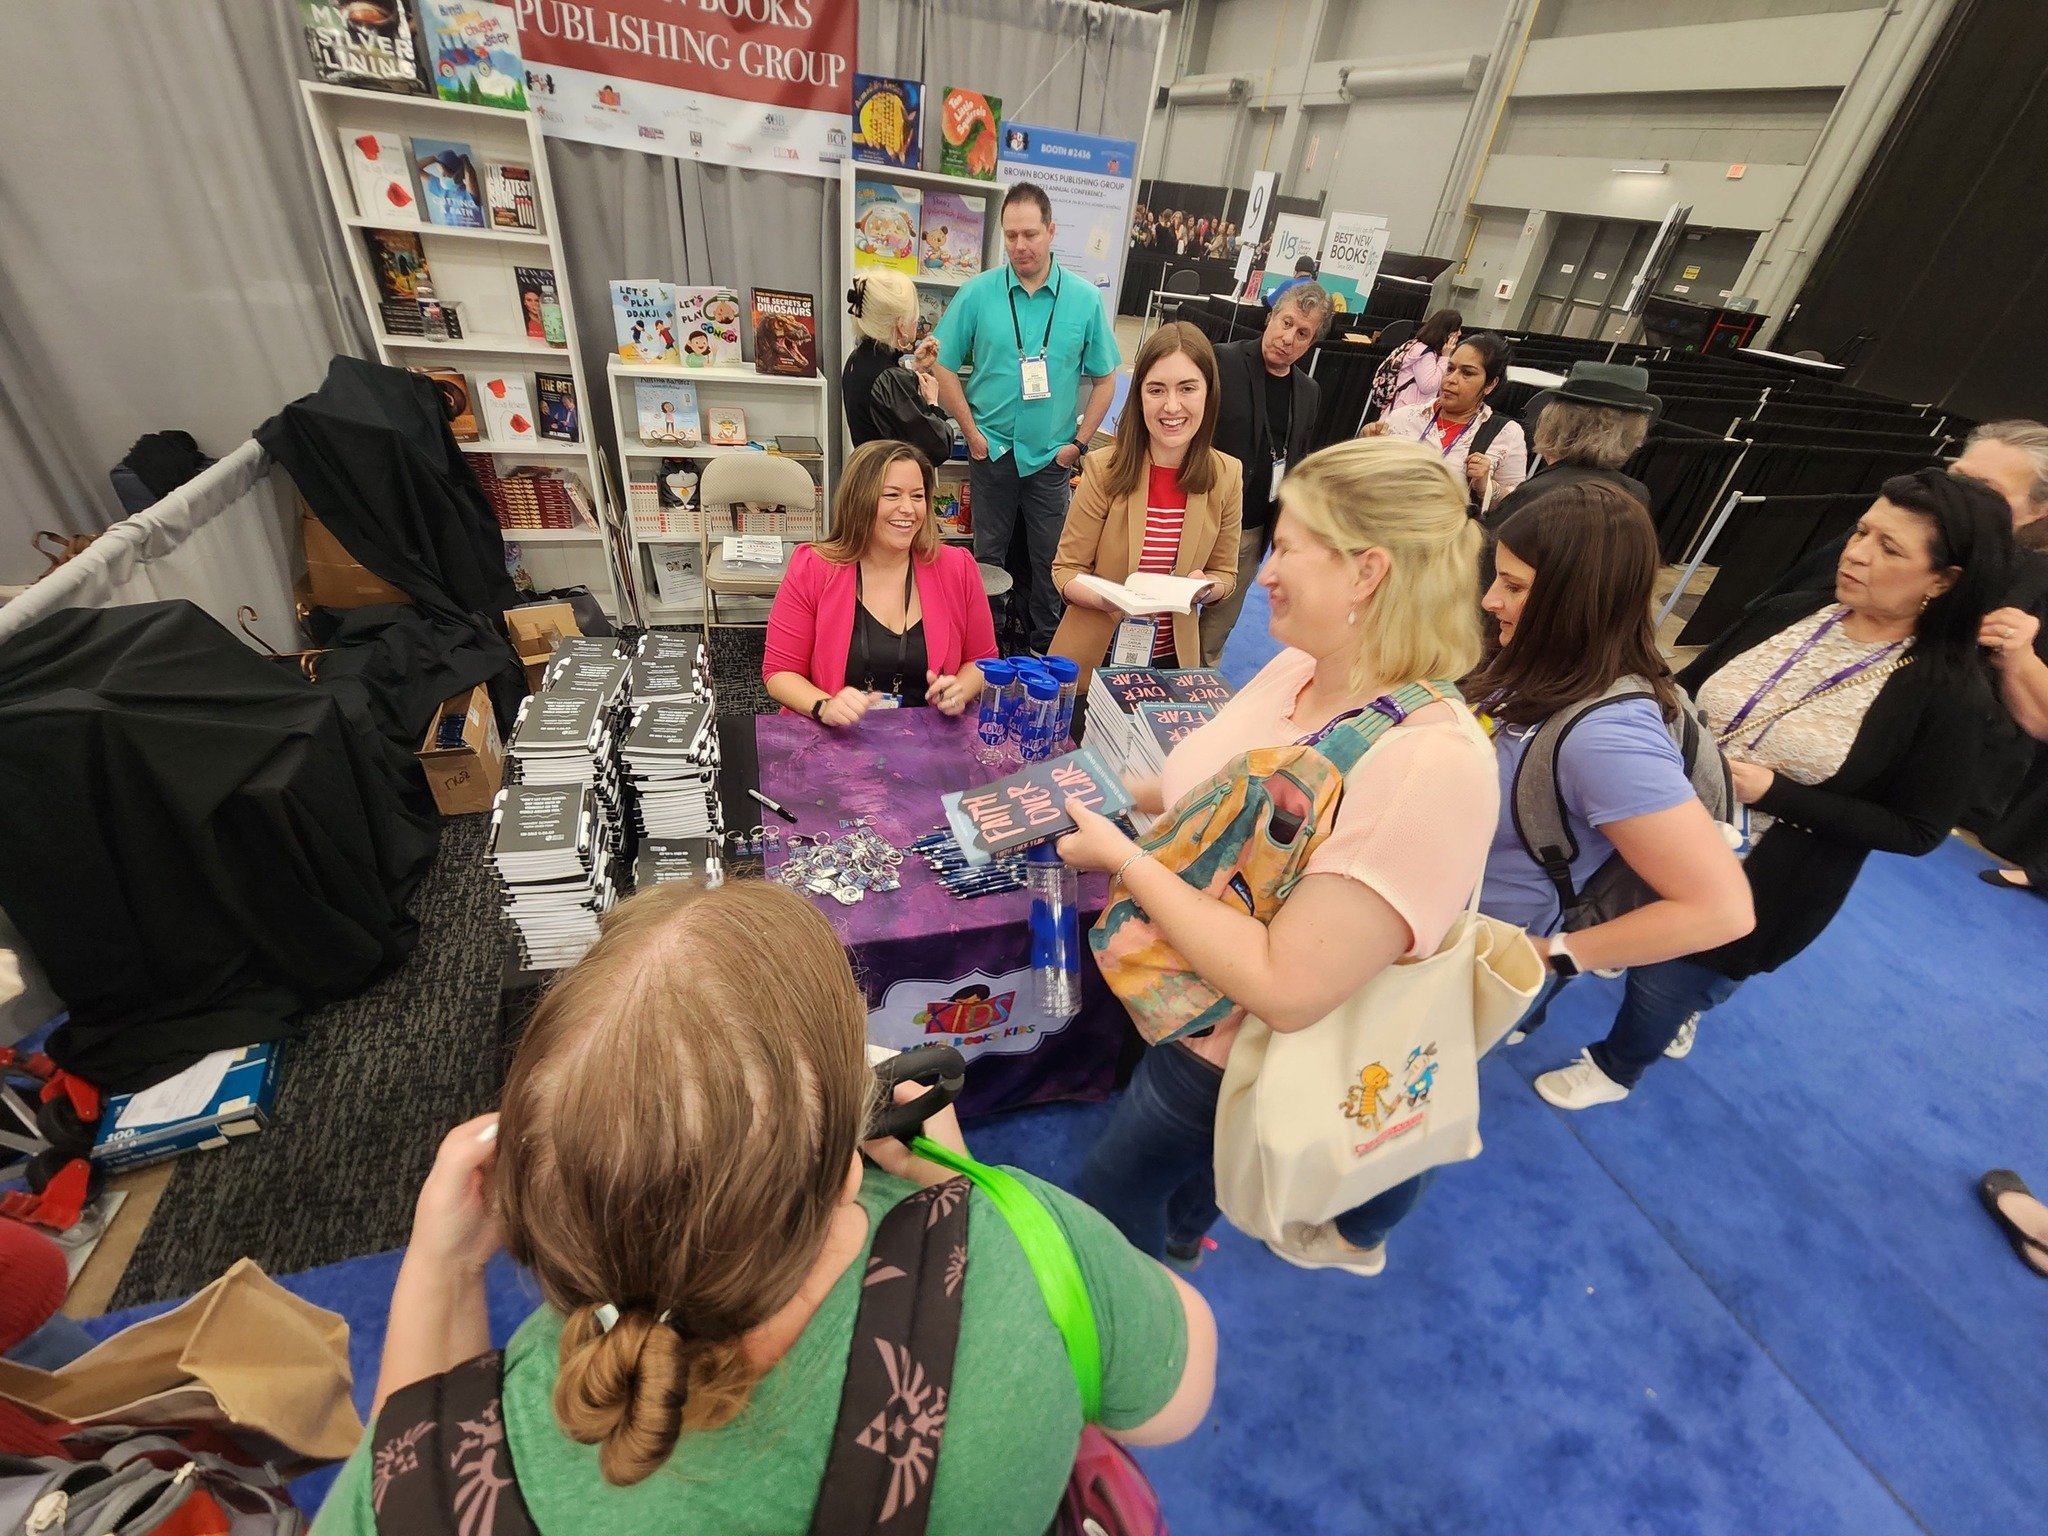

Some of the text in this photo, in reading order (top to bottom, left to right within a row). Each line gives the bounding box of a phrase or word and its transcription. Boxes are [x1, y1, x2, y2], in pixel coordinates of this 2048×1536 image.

[311, 3, 348, 27] MY
[317, 26, 415, 60] SILVER
[514, 0, 847, 88] PUBLISHING GROUP
[323, 48, 417, 80] LINING
[1041, 143, 1067, 156] BOOTH
[1004, 167, 1125, 190] BROWN BOOKS PUBLISHING GROUP
[433, 197, 476, 207] CUTTING
[1249, 185, 1264, 230] 9
[450, 206, 474, 217] PATH
[1276, 230, 1299, 260] jlg
[1334, 232, 1373, 247] BEST NEW
[1330, 245, 1369, 264] BOOKS
[619, 285, 648, 296] LET'S
[631, 298, 655, 308] PLAY
[679, 294, 704, 309] LET'S
[756, 296, 770, 305] THE
[771, 298, 802, 308] SECRETS
[626, 309, 660, 319] DDAKJI
[681, 309, 703, 325] PLAY
[757, 304, 812, 317] DINOSAURS
[700, 322, 738, 344] GONGGI
[539, 378, 573, 395] THE BET
[1107, 673, 1157, 686] FEAR
[1170, 674, 1220, 687] FEAR
[1121, 686, 1167, 701] OVER
[1185, 687, 1230, 702] OVER
[1152, 710, 1210, 724] FEAR
[1006, 780, 1062, 826] OVER
[961, 792, 1027, 844] FAITH
[926, 994, 1010, 1034] KIDS
[953, 1032, 998, 1047] BOOKS
[1004, 1024, 1035, 1038] KIDS
[105, 1128, 136, 1143] 100
